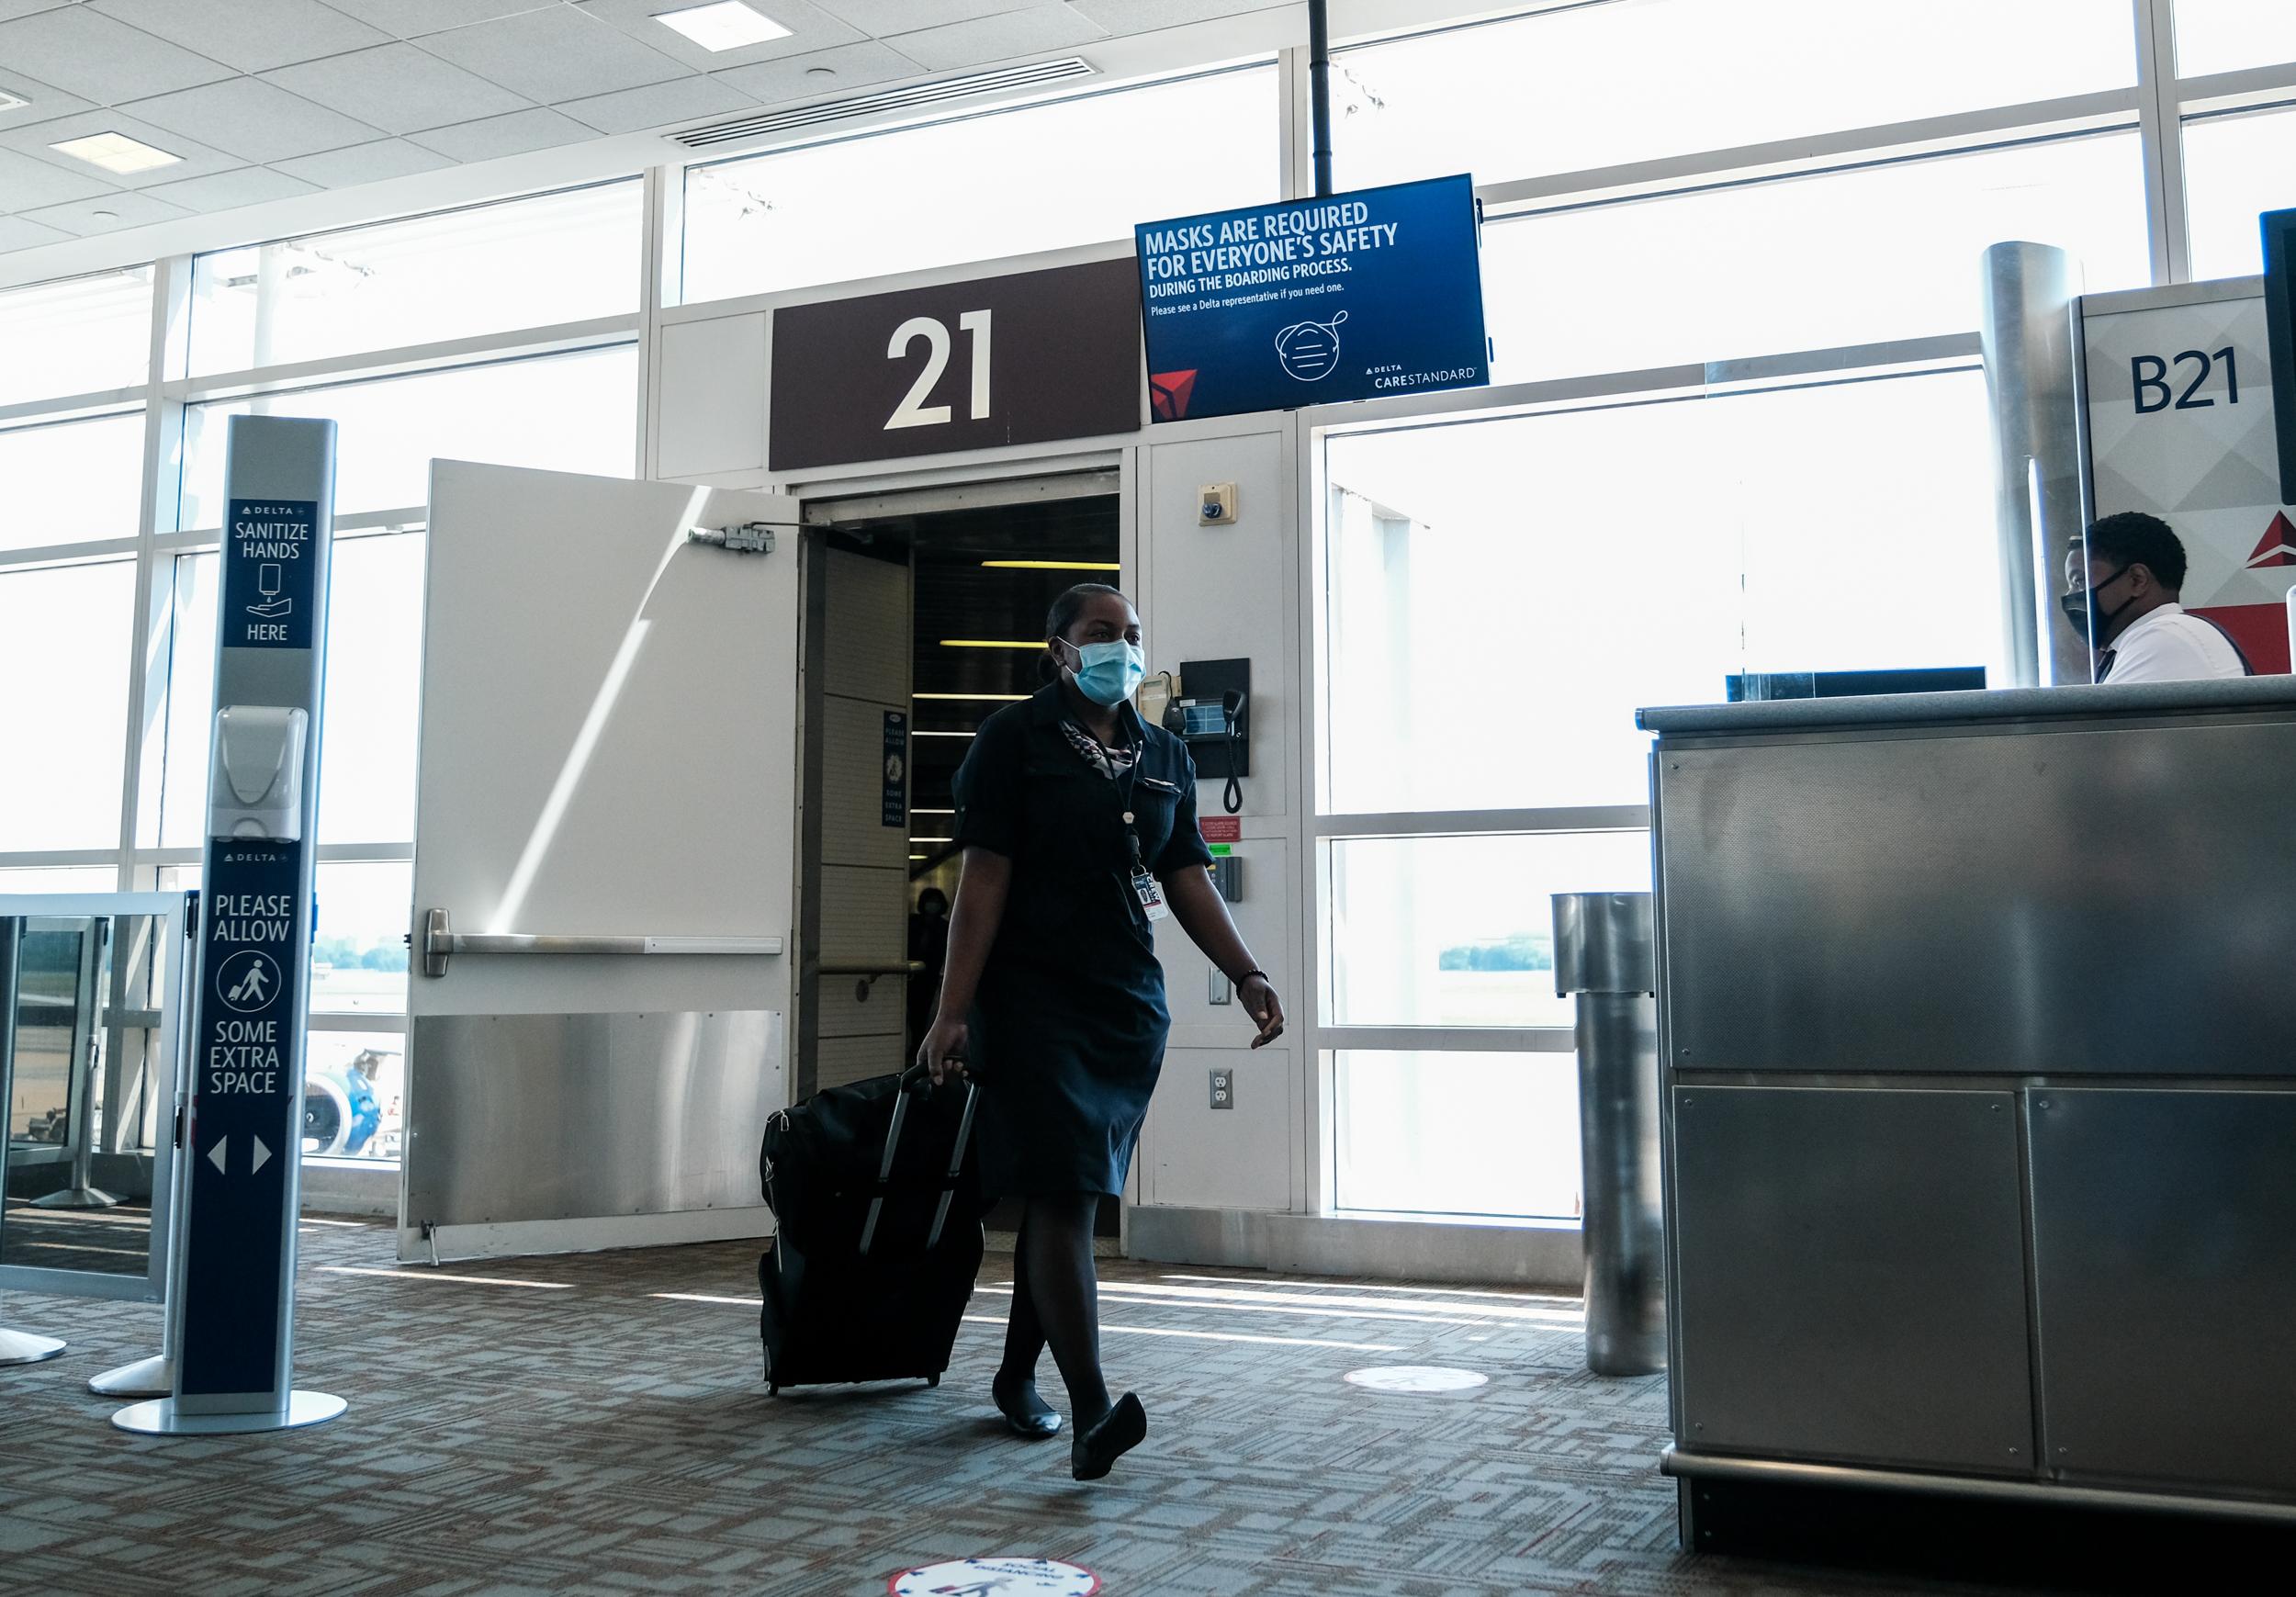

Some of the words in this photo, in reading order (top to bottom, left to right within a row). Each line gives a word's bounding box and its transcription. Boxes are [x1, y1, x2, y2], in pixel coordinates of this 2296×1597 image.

[1145, 224, 1214, 255] MASKS
[1219, 217, 1259, 245] ARE
[1264, 201, 1368, 238] REQUIRED
[1147, 254, 1187, 280] FOR
[1190, 235, 1315, 274] EVERYONE'S
[1319, 222, 1398, 255] SAFETY
[1149, 279, 1196, 298] DURING
[1198, 275, 1222, 292] THE
[1224, 265, 1290, 288] BOARDING
[1292, 257, 1353, 279] PROCESS.
[1151, 306, 1176, 316] Please
[1177, 304, 1191, 313] see
[1199, 298, 1221, 309] Delta
[1221, 290, 1278, 307] representative
[1280, 288, 1287, 298] if
[1288, 287, 1303, 300] you
[1304, 282, 1325, 295] need
[1326, 283, 1345, 293] one.
[883, 309, 992, 431] 21
[1374, 365, 1402, 374] DELTA
[2130, 345, 2240, 415] B21
[254, 506, 293, 515] DELTA
[234, 522, 309, 540] SANITIZE
[242, 542, 299, 559] HANDS
[247, 624, 287, 641] HERE
[237, 853, 276, 861] DELTA
[1146, 875, 1160, 901] CREW
[215, 894, 291, 917] PLEASE
[213, 919, 290, 942] ALLOW
[215, 1020, 277, 1043] SOME
[209, 1046, 280, 1069] EXTRA
[210, 1071, 276, 1094] SPACE
